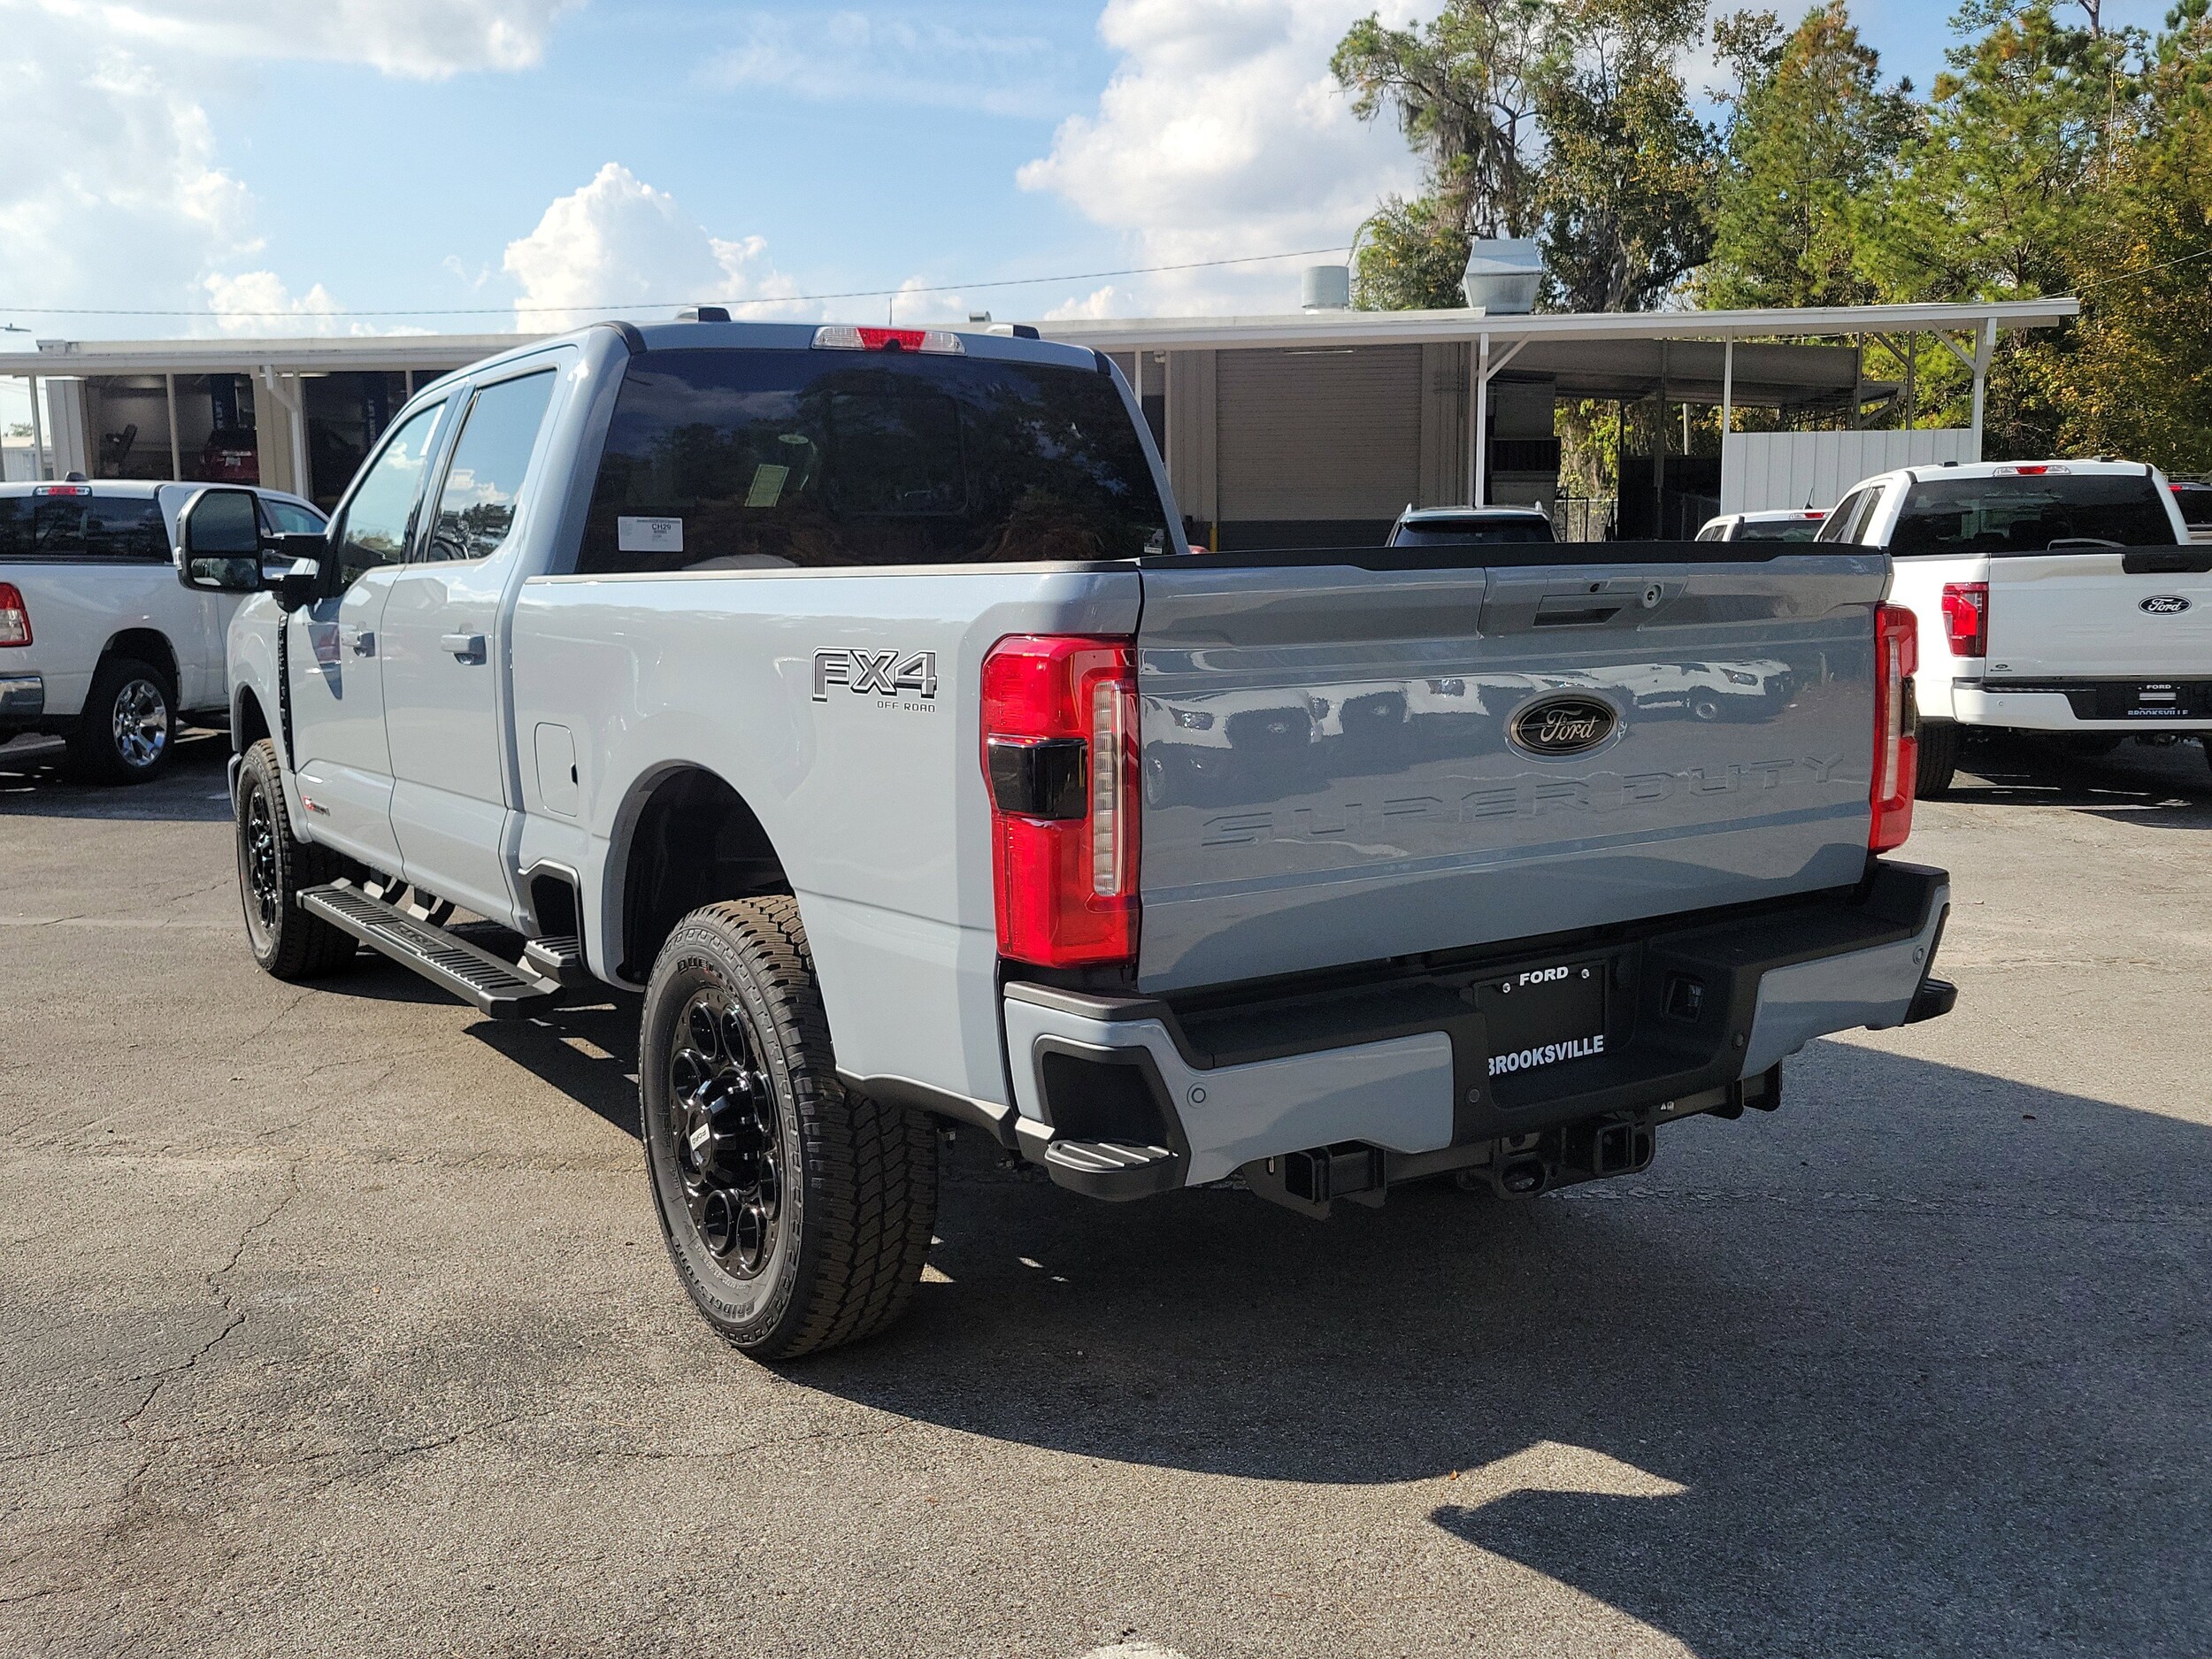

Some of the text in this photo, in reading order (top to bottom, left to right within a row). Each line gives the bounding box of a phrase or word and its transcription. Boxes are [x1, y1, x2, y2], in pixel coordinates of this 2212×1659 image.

[2147, 598, 2182, 611] Ford
[811, 647, 937, 703] FX4
[877, 700, 935, 713] OFF ROAD
[1201, 754, 1846, 849] SUPER DUTY
[1519, 966, 1569, 986] FORD
[1488, 1034, 1604, 1076] BROOKSVILLE
